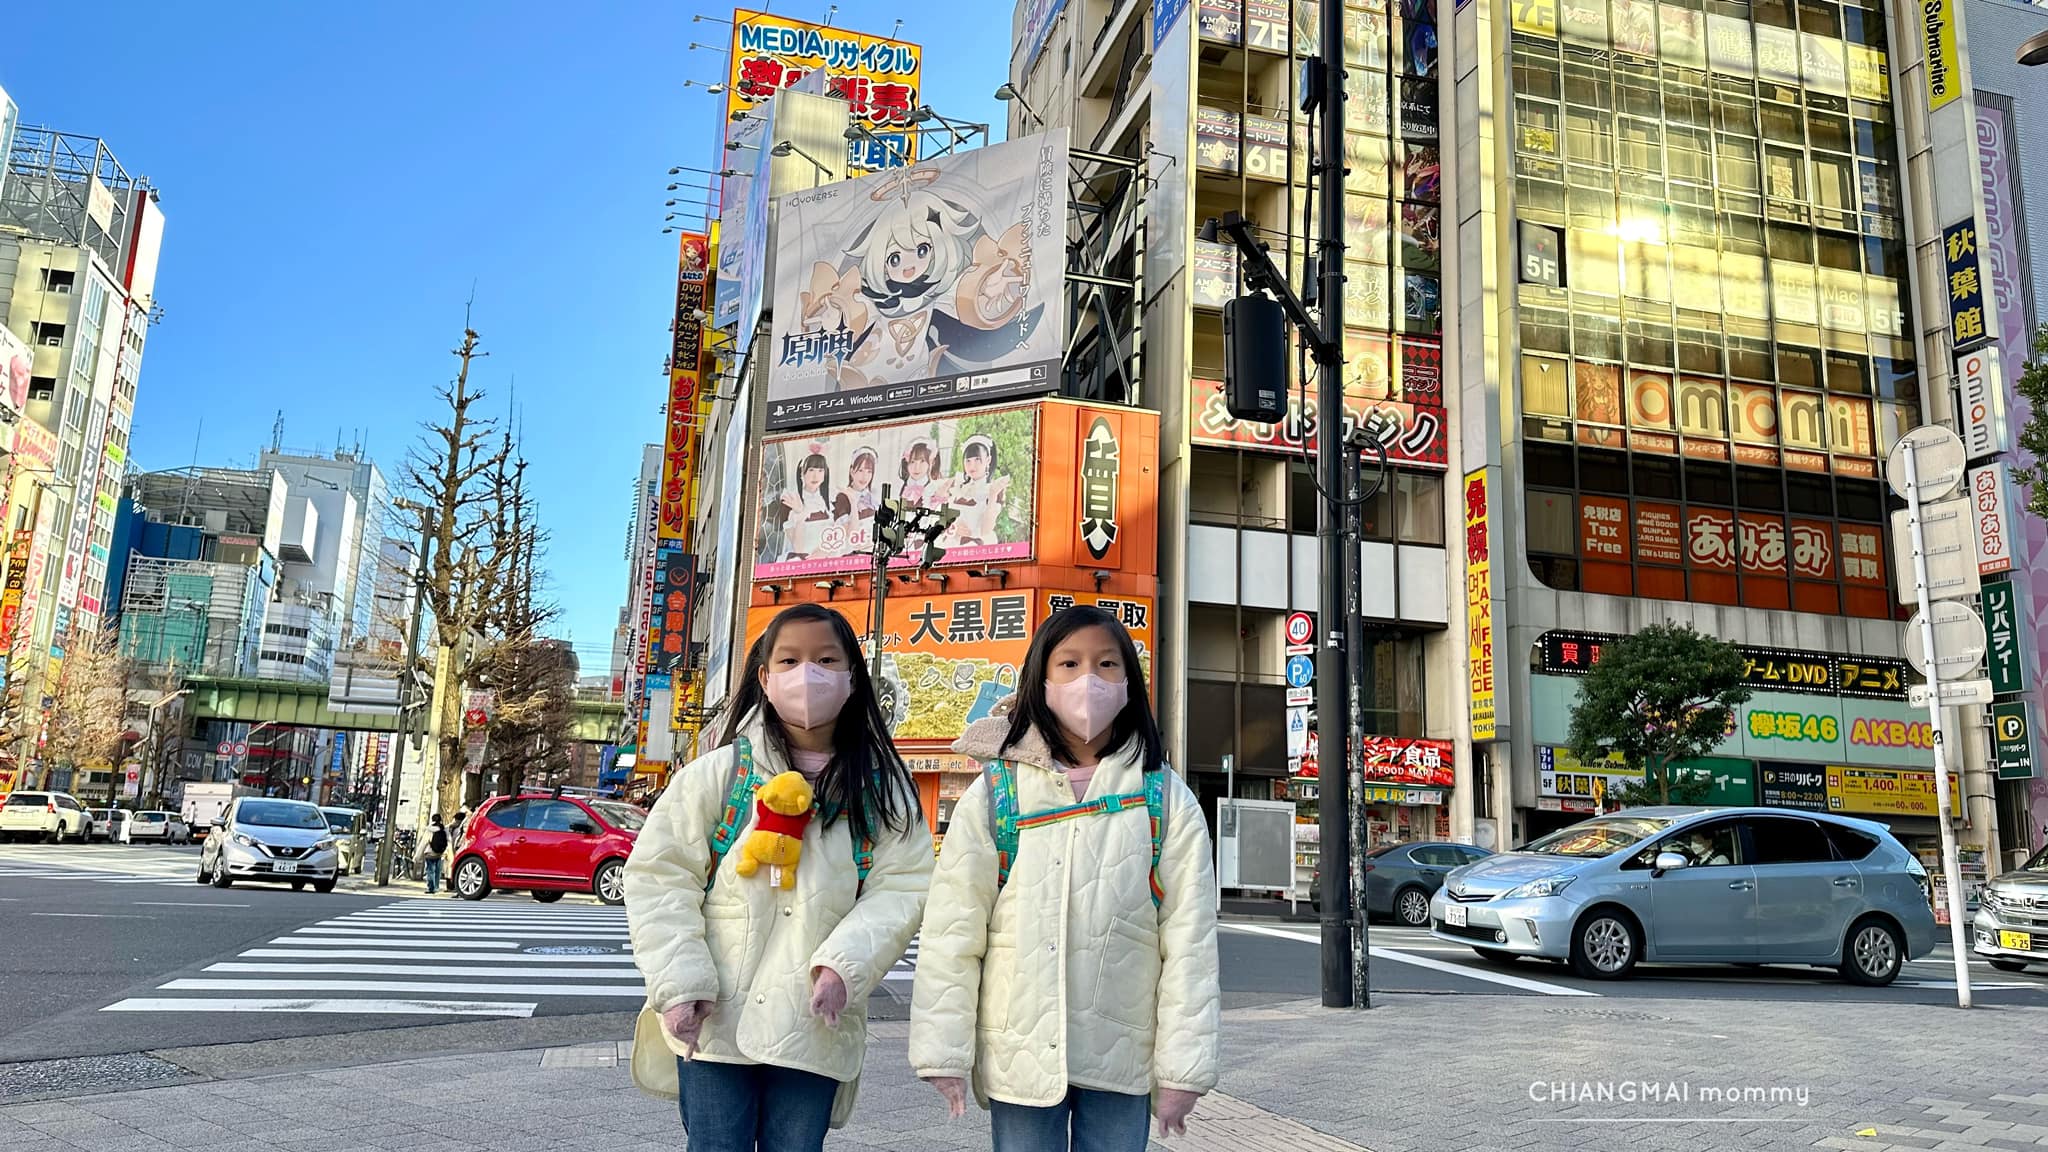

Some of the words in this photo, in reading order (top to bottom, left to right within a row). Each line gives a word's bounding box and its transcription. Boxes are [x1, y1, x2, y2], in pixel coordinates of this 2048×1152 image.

[1517, 0, 1553, 26] 7F
[1250, 19, 1289, 52] 7F
[741, 24, 916, 74] MEDIAリサイクル
[1924, 0, 1946, 98] Submarine
[1850, 57, 1888, 75] GAME
[738, 58, 911, 123] 激販売
[1245, 146, 1288, 178] 6F
[1525, 254, 1556, 279] 5F
[681, 283, 701, 293] DVD
[1824, 284, 1859, 301] Mac
[1945, 227, 1984, 341] 秋葉館
[682, 312, 696, 321] CD
[1874, 307, 1905, 333] 5F
[677, 331, 698, 340] アニメ
[677, 341, 697, 350] コミック
[778, 318, 868, 380] 原神
[786, 402, 812, 415] PS5
[818, 398, 845, 410] PS4
[850, 393, 883, 405] Windows
[1966, 356, 1990, 453] amiami
[1465, 477, 1488, 566] 免税
[1583, 505, 1621, 522] 免税店
[1641, 511, 1671, 521] FIGURES
[1976, 470, 2003, 556] あみあみ
[1588, 521, 1618, 538] Tax
[1642, 527, 1672, 536] GUNPLA
[1586, 538, 1622, 554] Free
[1689, 515, 1830, 576] あみあみ
[1843, 556, 1879, 580] 買取
[1479, 569, 1491, 618] TAX
[909, 595, 1027, 645] 大黒屋
[1291, 620, 1307, 636] 40
[1468, 572, 1484, 693] 면세점
[1989, 590, 2013, 684] リバティー
[1482, 626, 1494, 692] FREE
[1292, 664, 1303, 683] P
[1840, 663, 1900, 691] アニメ
[1749, 710, 1840, 742] 欅坂46
[1850, 716, 1934, 750] AKB48
[2007, 719, 2019, 737] P
[1378, 766, 1405, 776] FOOD
[1408, 767, 1435, 777] MART
[2019, 758, 2031, 768] IN
[1542, 779, 1553, 789] 5F
[1778, 771, 1823, 787] 三井のリパーク
